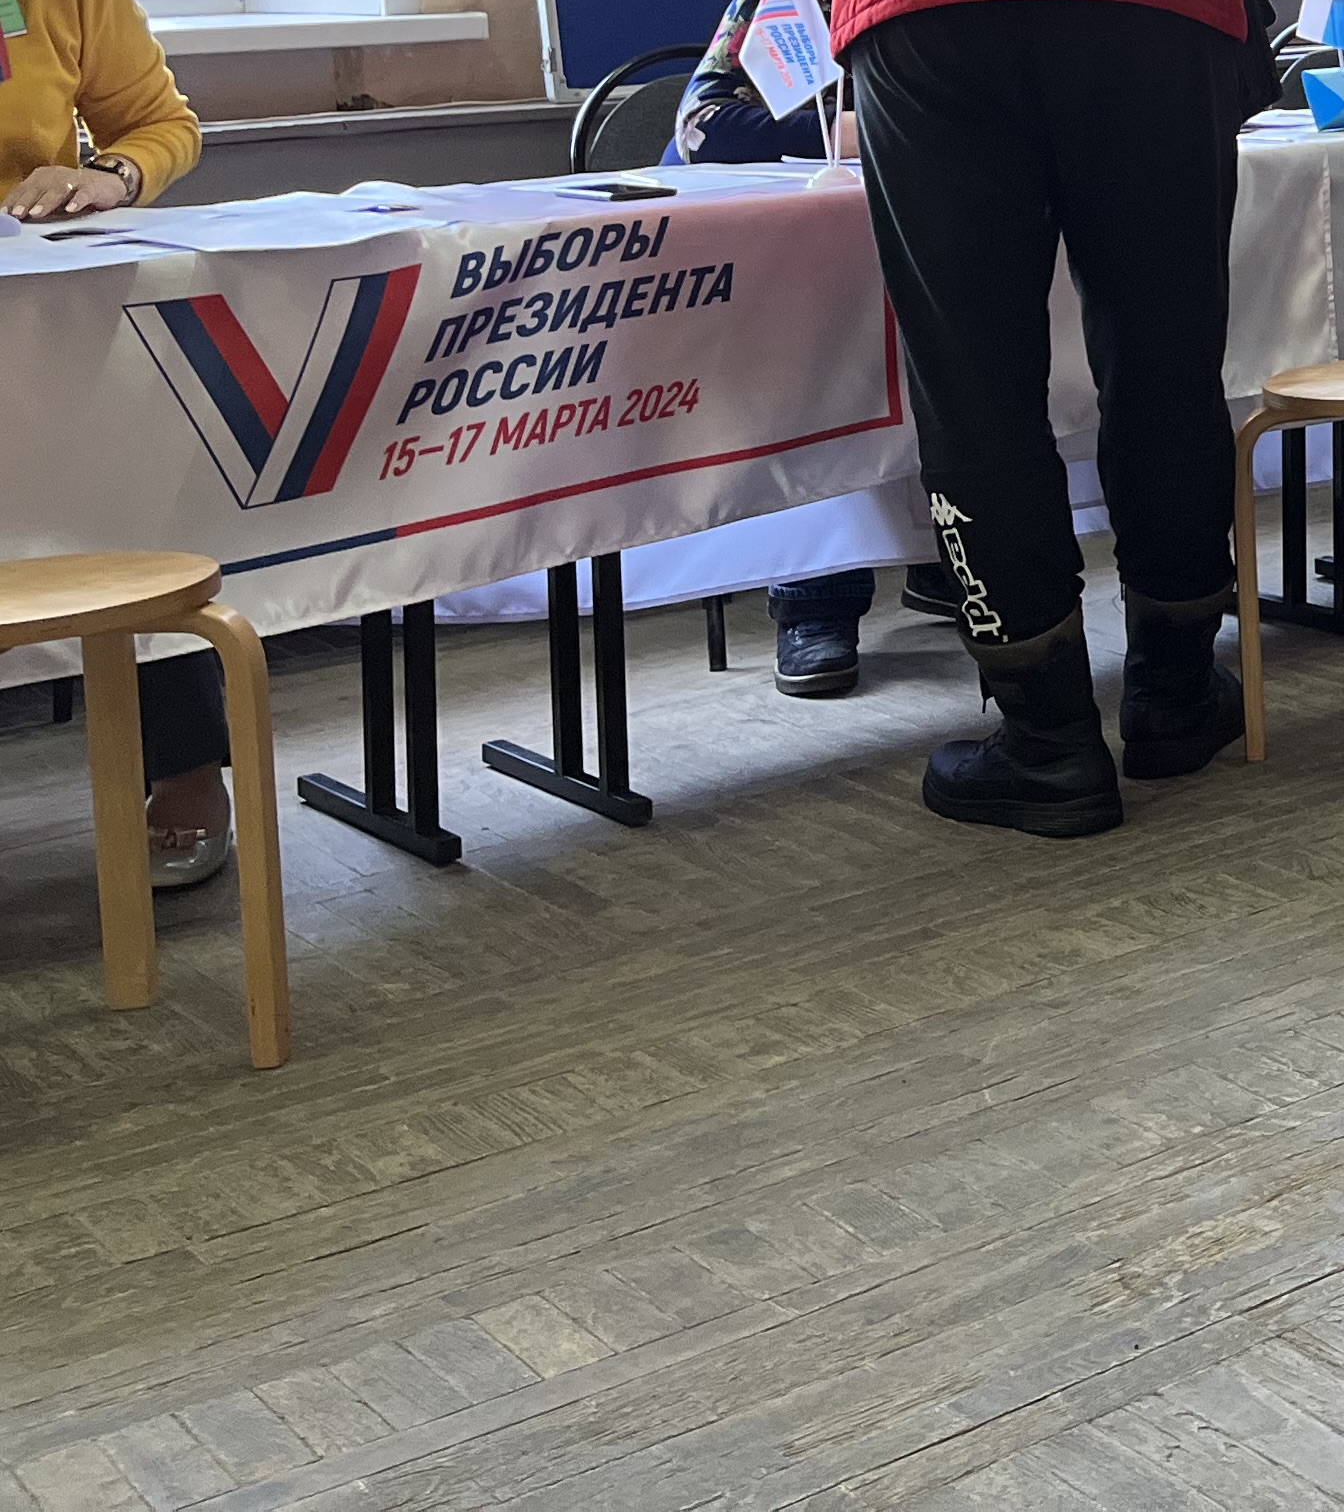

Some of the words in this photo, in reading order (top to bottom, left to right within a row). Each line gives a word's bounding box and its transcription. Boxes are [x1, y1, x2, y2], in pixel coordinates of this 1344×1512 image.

[765, 25, 796, 64] РОССИИ
[781, 23, 815, 86] ПРЕЗИДЕНТА
[794, 23, 819, 66] ВЫБОРЫ
[451, 216, 671, 299] ВЫБОРЫ
[424, 262, 735, 363] ПРЕЗИДЕНТА
[397, 341, 608, 425] РОССИИ
[490, 396, 613, 457] МАРТА
[618, 377, 701, 429] 2024
